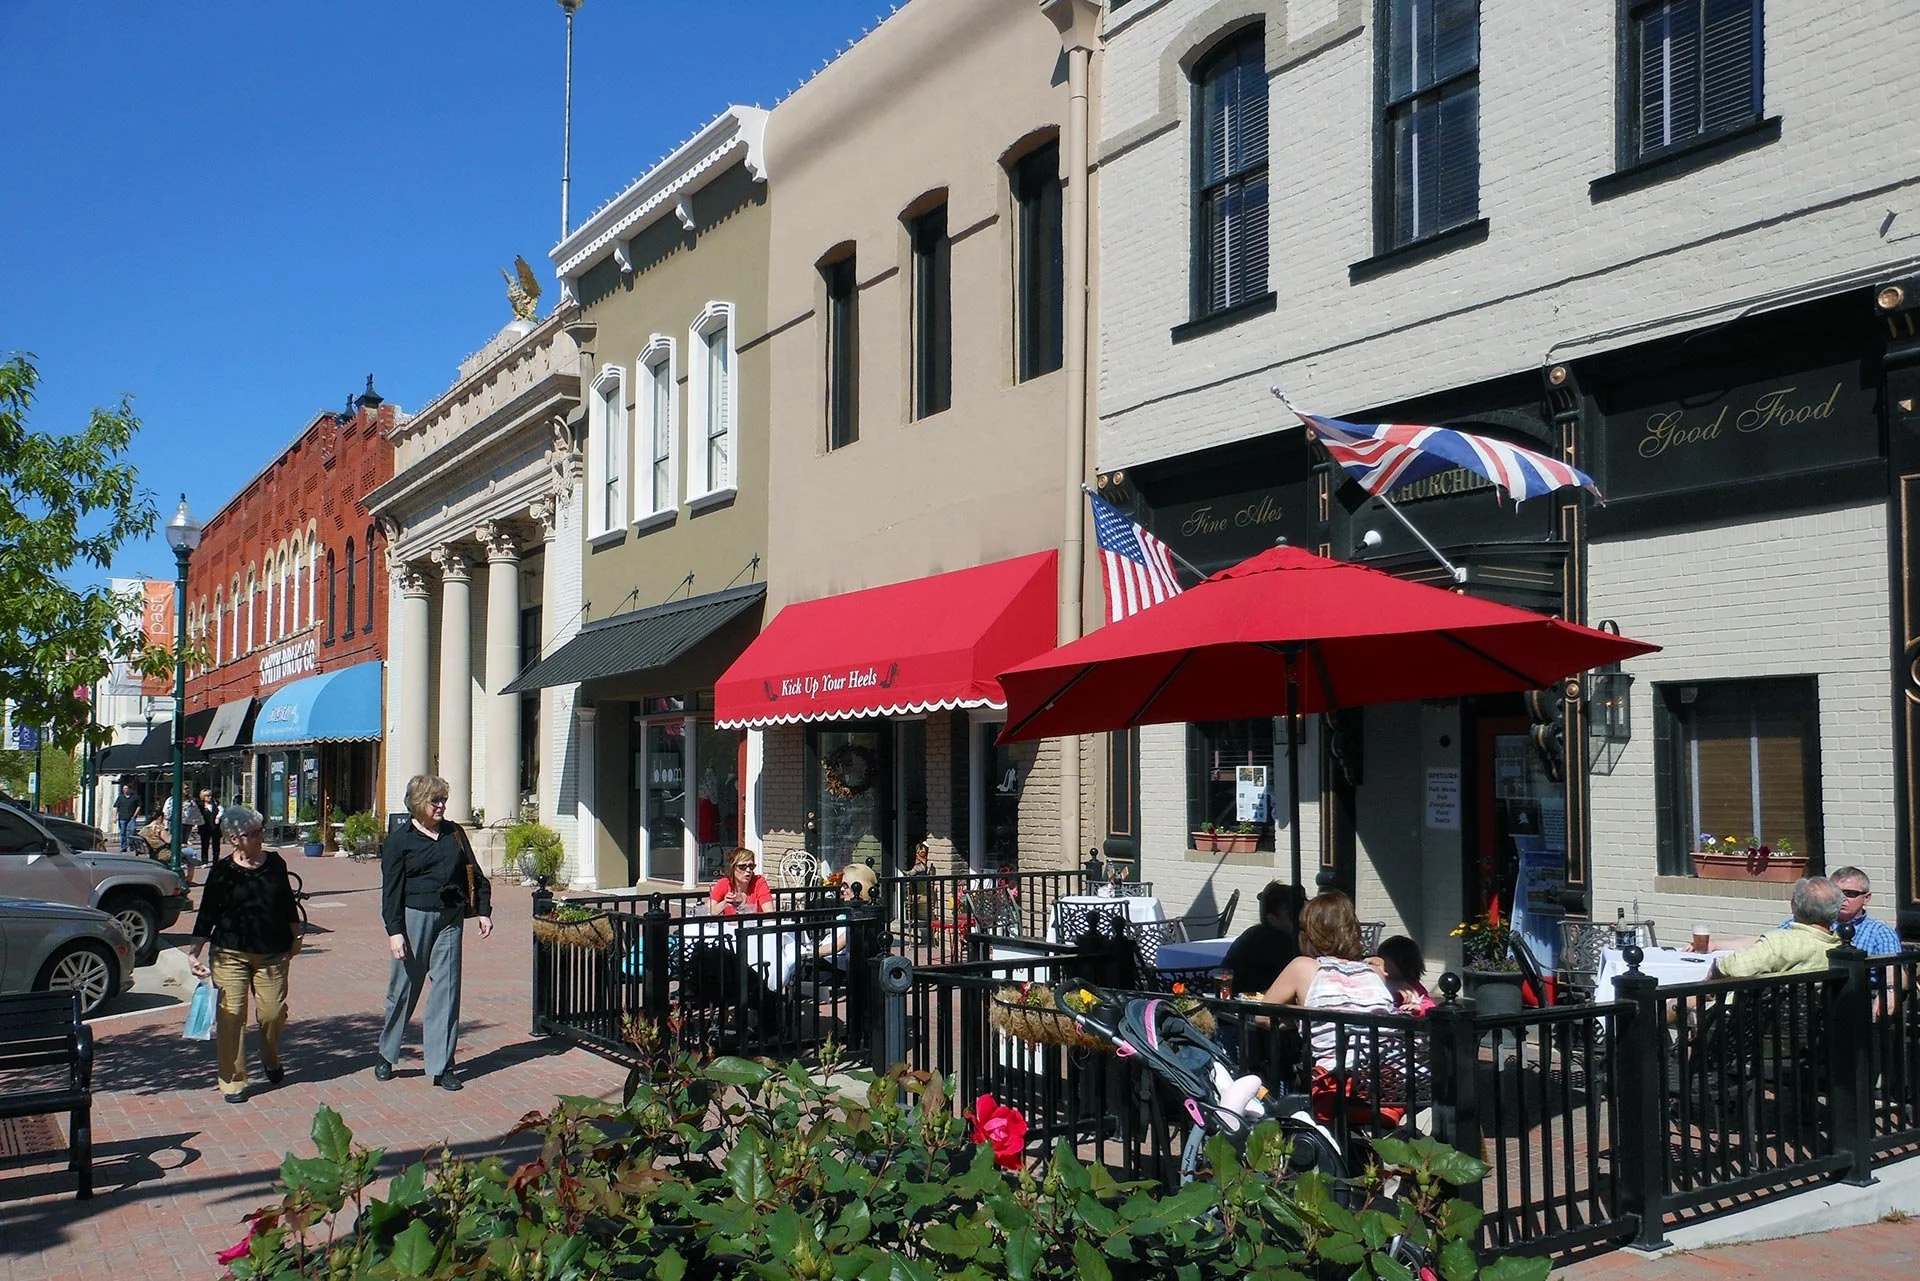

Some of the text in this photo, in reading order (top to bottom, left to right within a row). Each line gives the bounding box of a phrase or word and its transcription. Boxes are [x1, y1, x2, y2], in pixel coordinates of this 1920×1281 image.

[1638, 382, 1843, 459] Good Food
[1181, 495, 1284, 538] Fine Ales
[260, 651, 281, 685] SMITH
[281, 643, 302, 677] DRUG
[781, 667, 878, 699] Kick Up Your Heels
[653, 759, 683, 783] bloom
